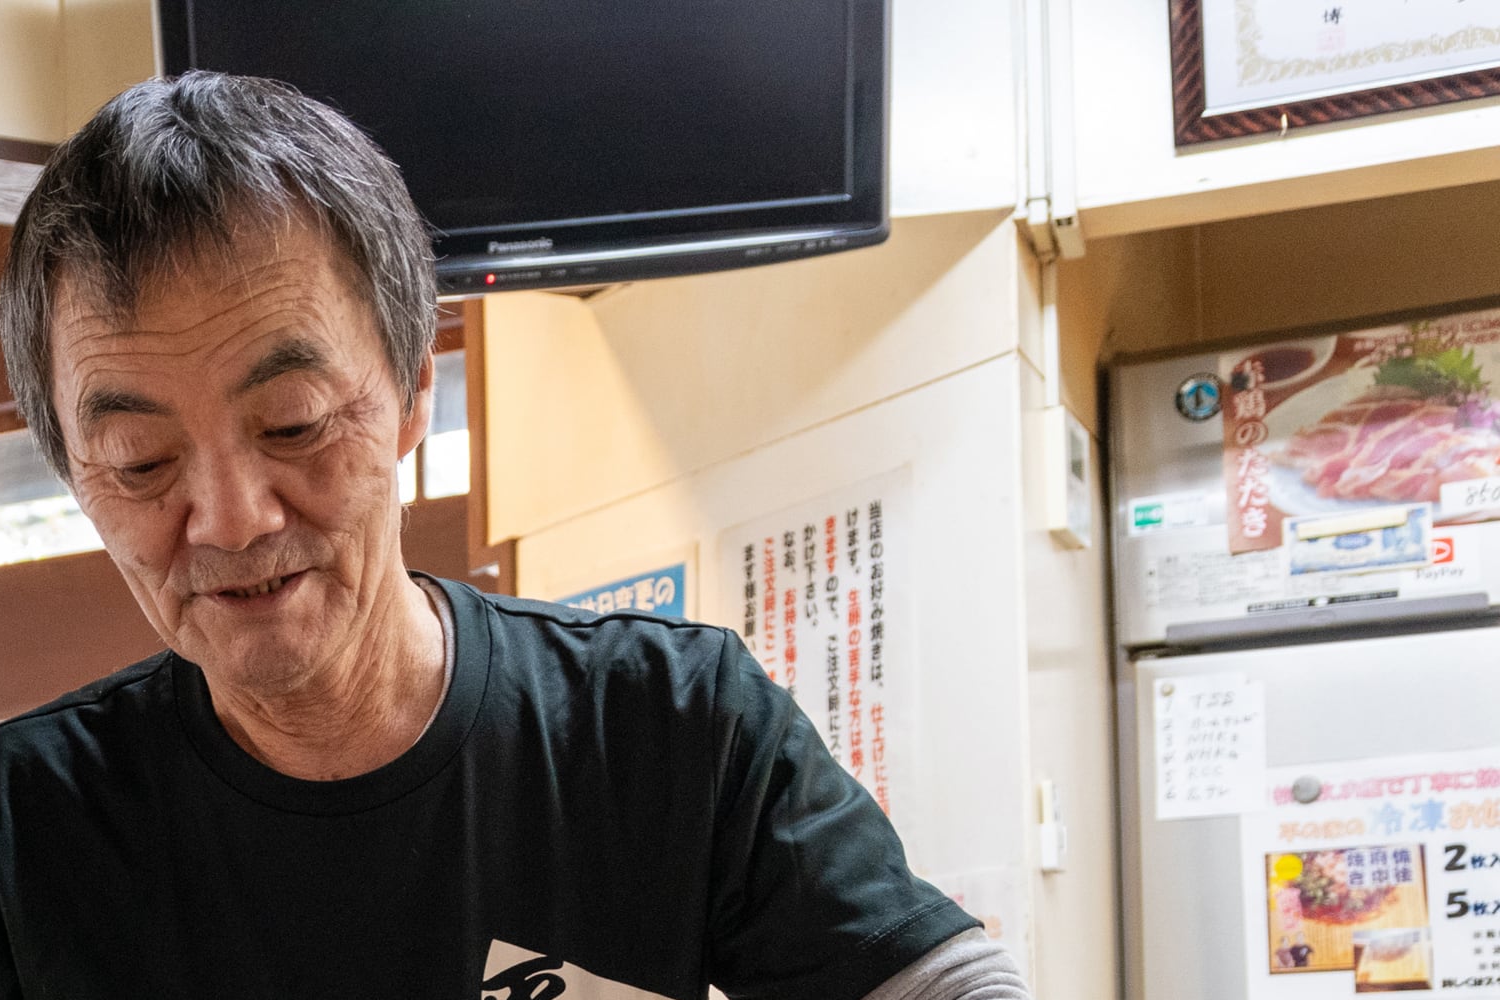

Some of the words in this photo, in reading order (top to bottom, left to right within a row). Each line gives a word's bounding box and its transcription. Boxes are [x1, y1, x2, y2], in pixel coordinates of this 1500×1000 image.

[488, 237, 554, 253] Panasonic
[568, 576, 676, 614] 日変更の
